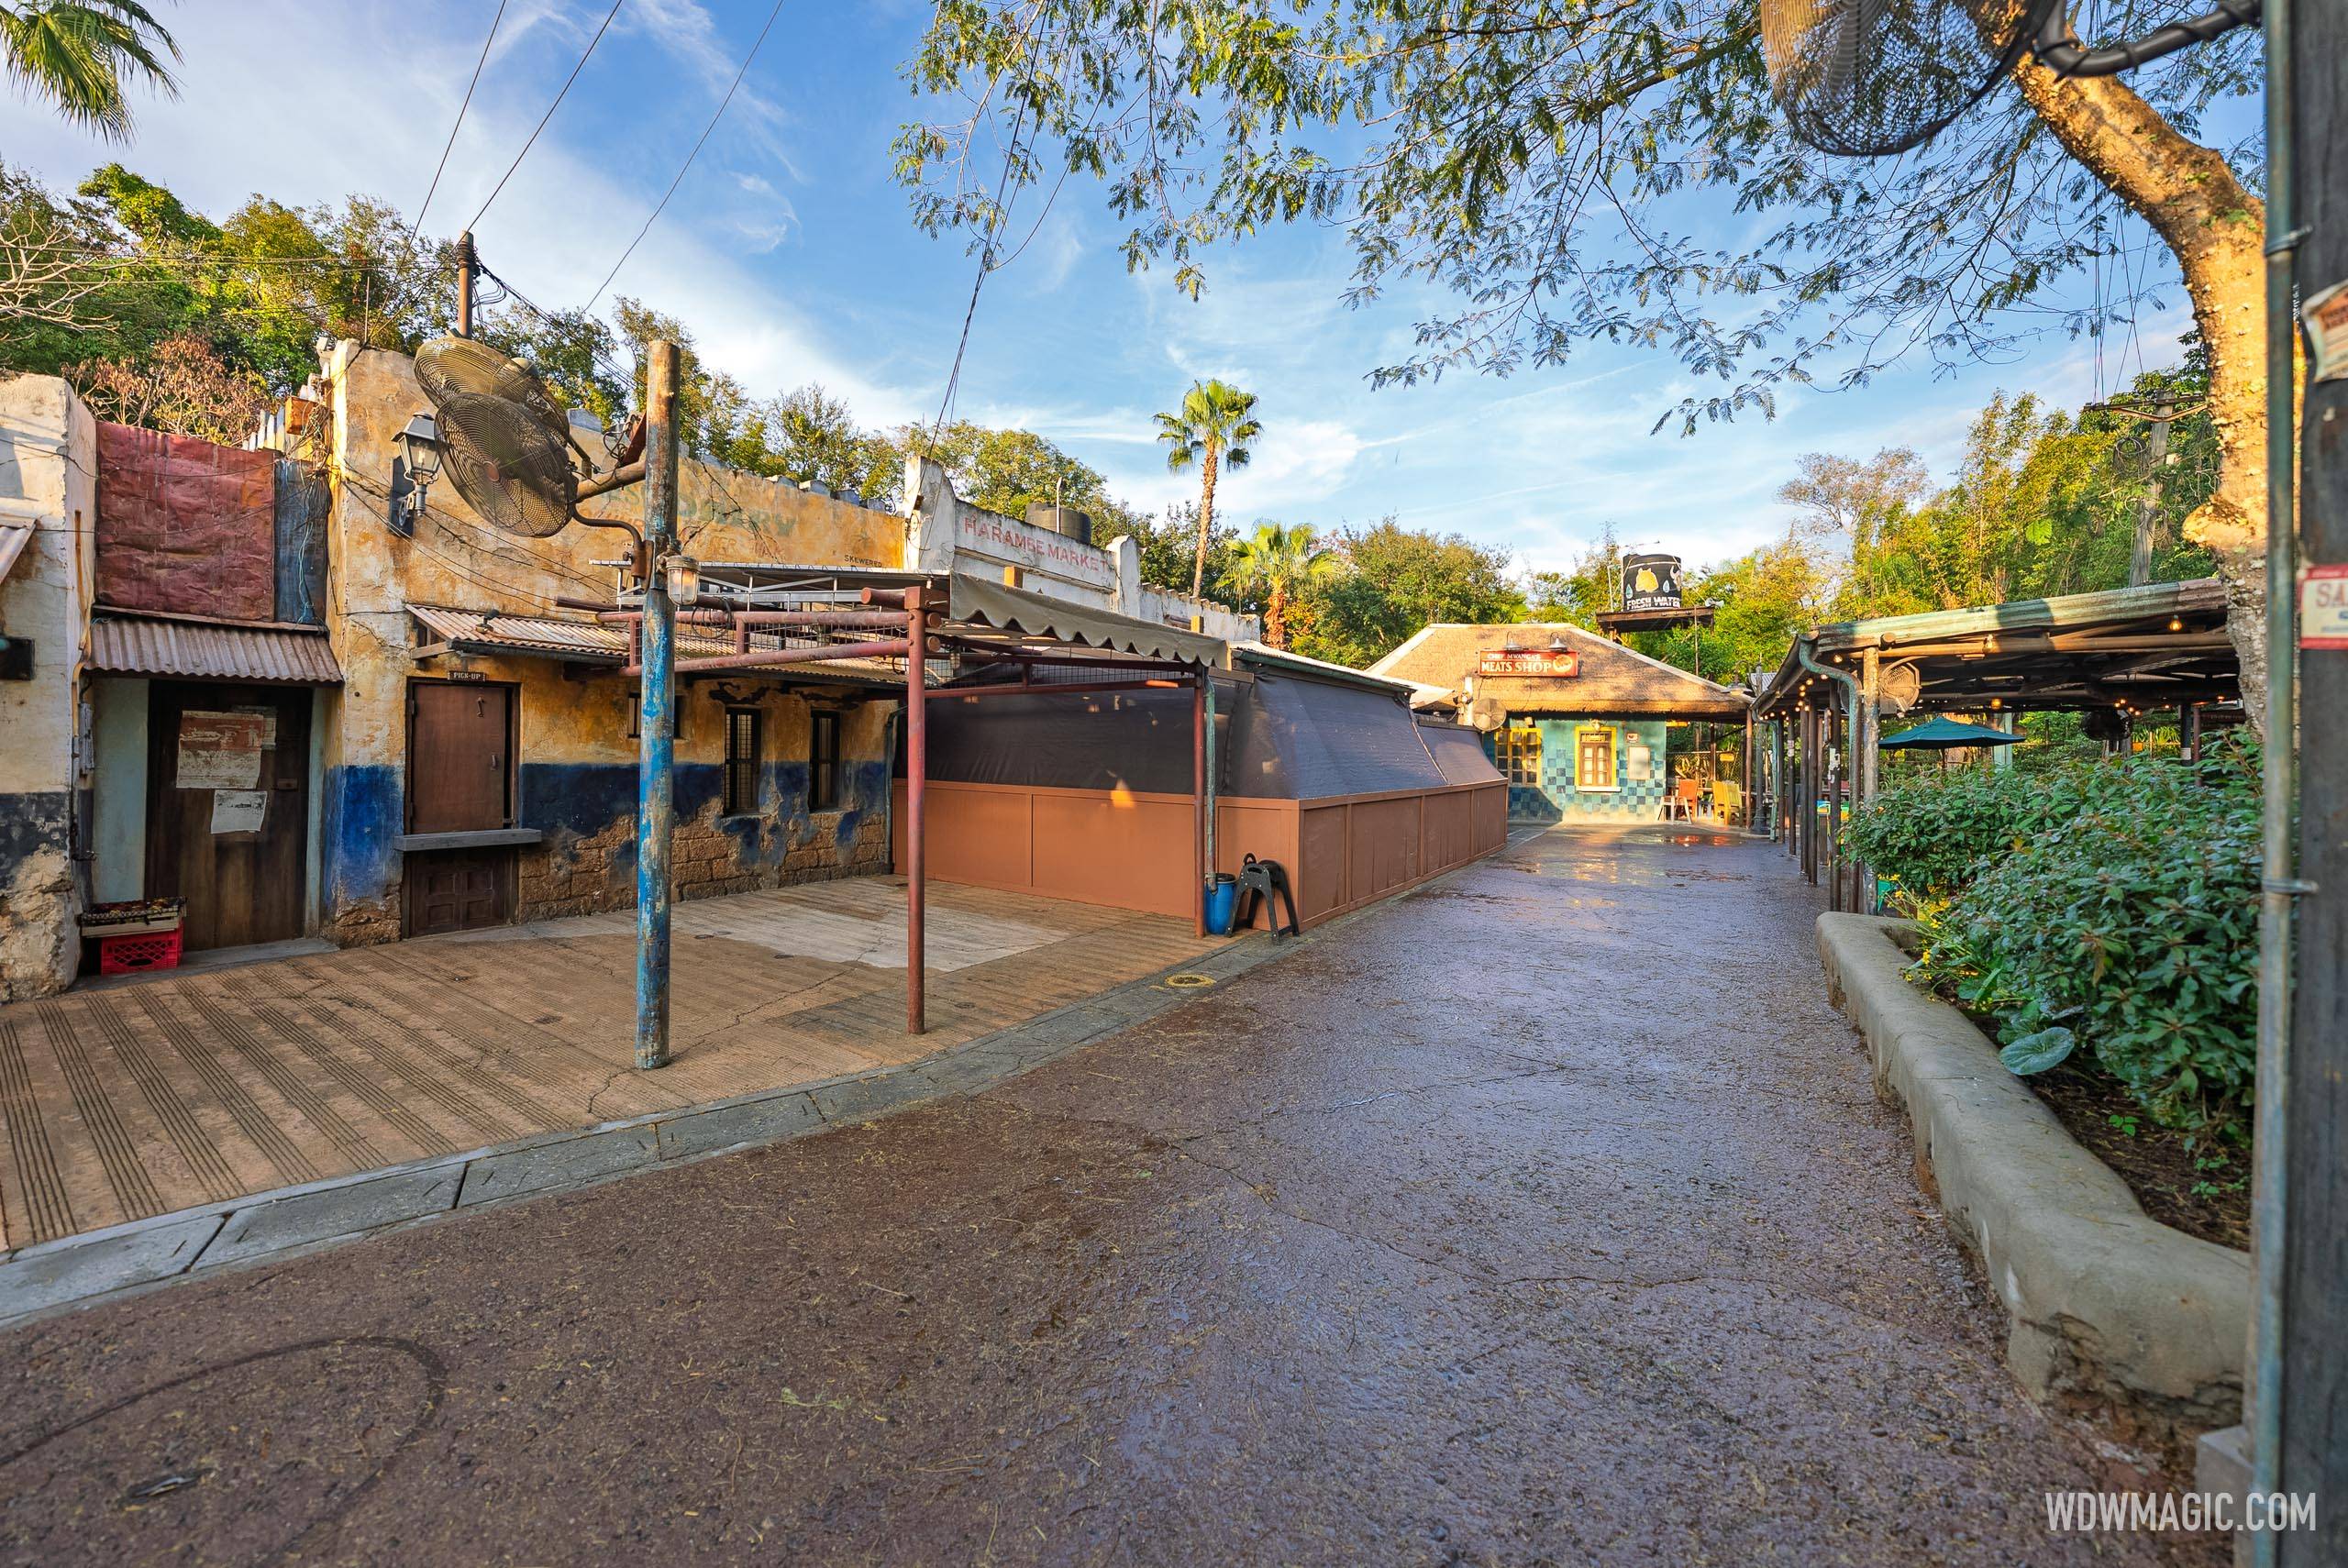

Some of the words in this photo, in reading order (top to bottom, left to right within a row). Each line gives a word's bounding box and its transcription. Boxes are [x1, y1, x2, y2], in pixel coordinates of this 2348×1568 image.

[964, 516, 1045, 556] HARAMBE
[1047, 543, 1109, 571] MARKET
[844, 554, 882, 568] SKEWERED
[1626, 596, 1652, 610] FRESH
[1481, 661, 1513, 672] MEATS
[1514, 661, 1552, 673] SHOP
[453, 671, 481, 679] PICK-UP
